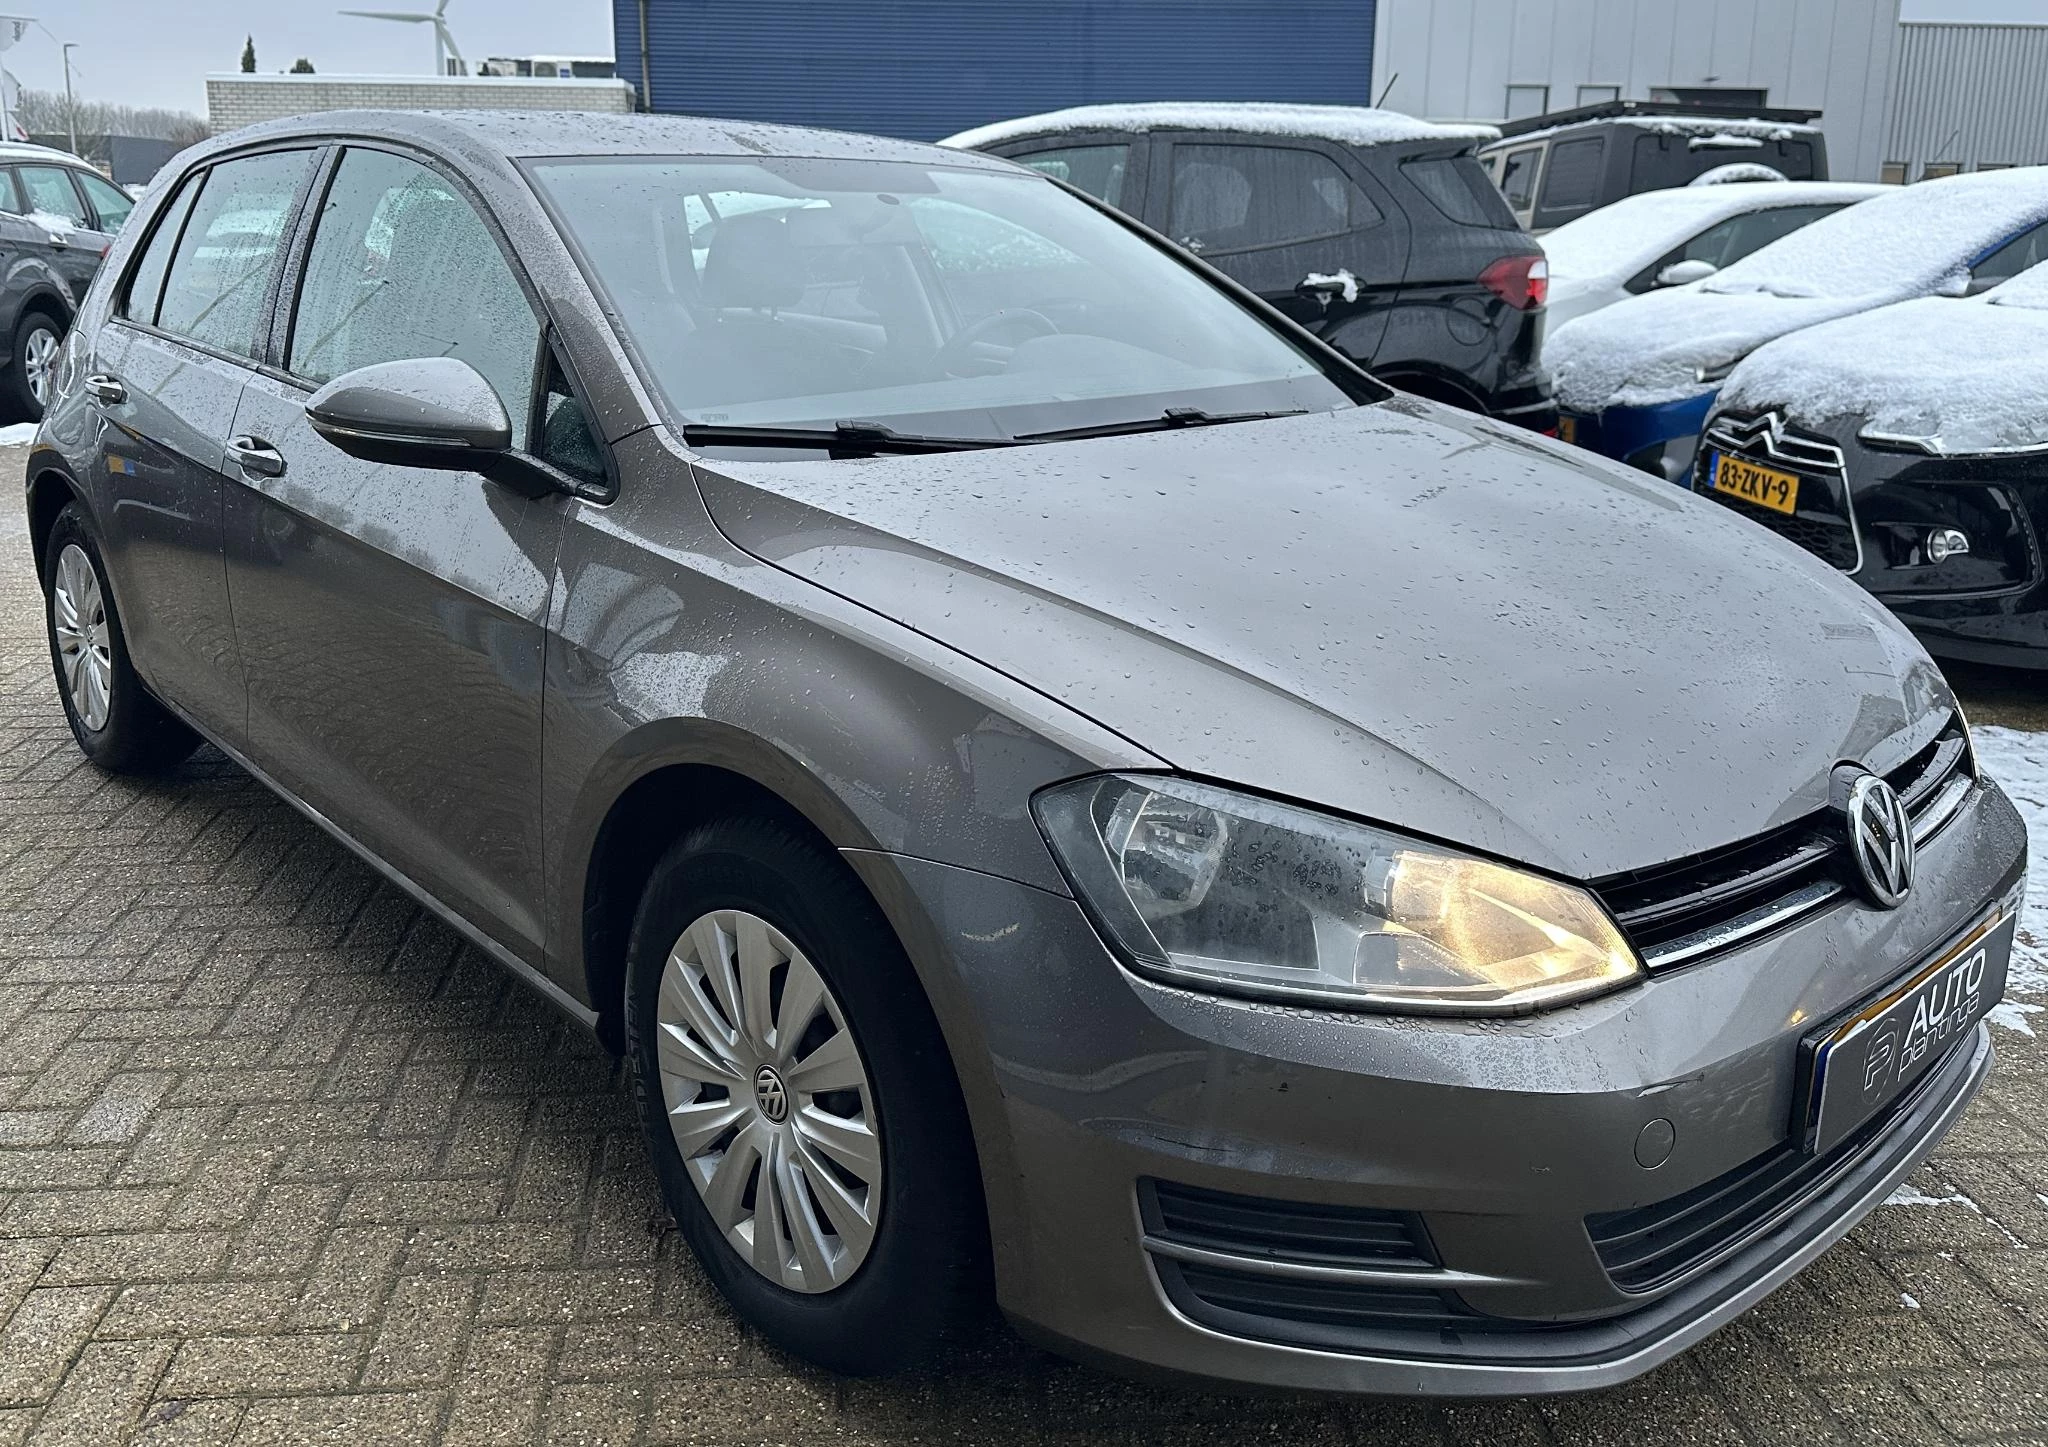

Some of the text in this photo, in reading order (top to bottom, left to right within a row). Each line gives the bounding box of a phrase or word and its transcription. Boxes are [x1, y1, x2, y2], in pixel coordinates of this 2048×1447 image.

[1720, 461, 1789, 505] 83-ZKV-9
[1897, 991, 1980, 1082] plantinga
[1903, 948, 1986, 1048] AUTO
